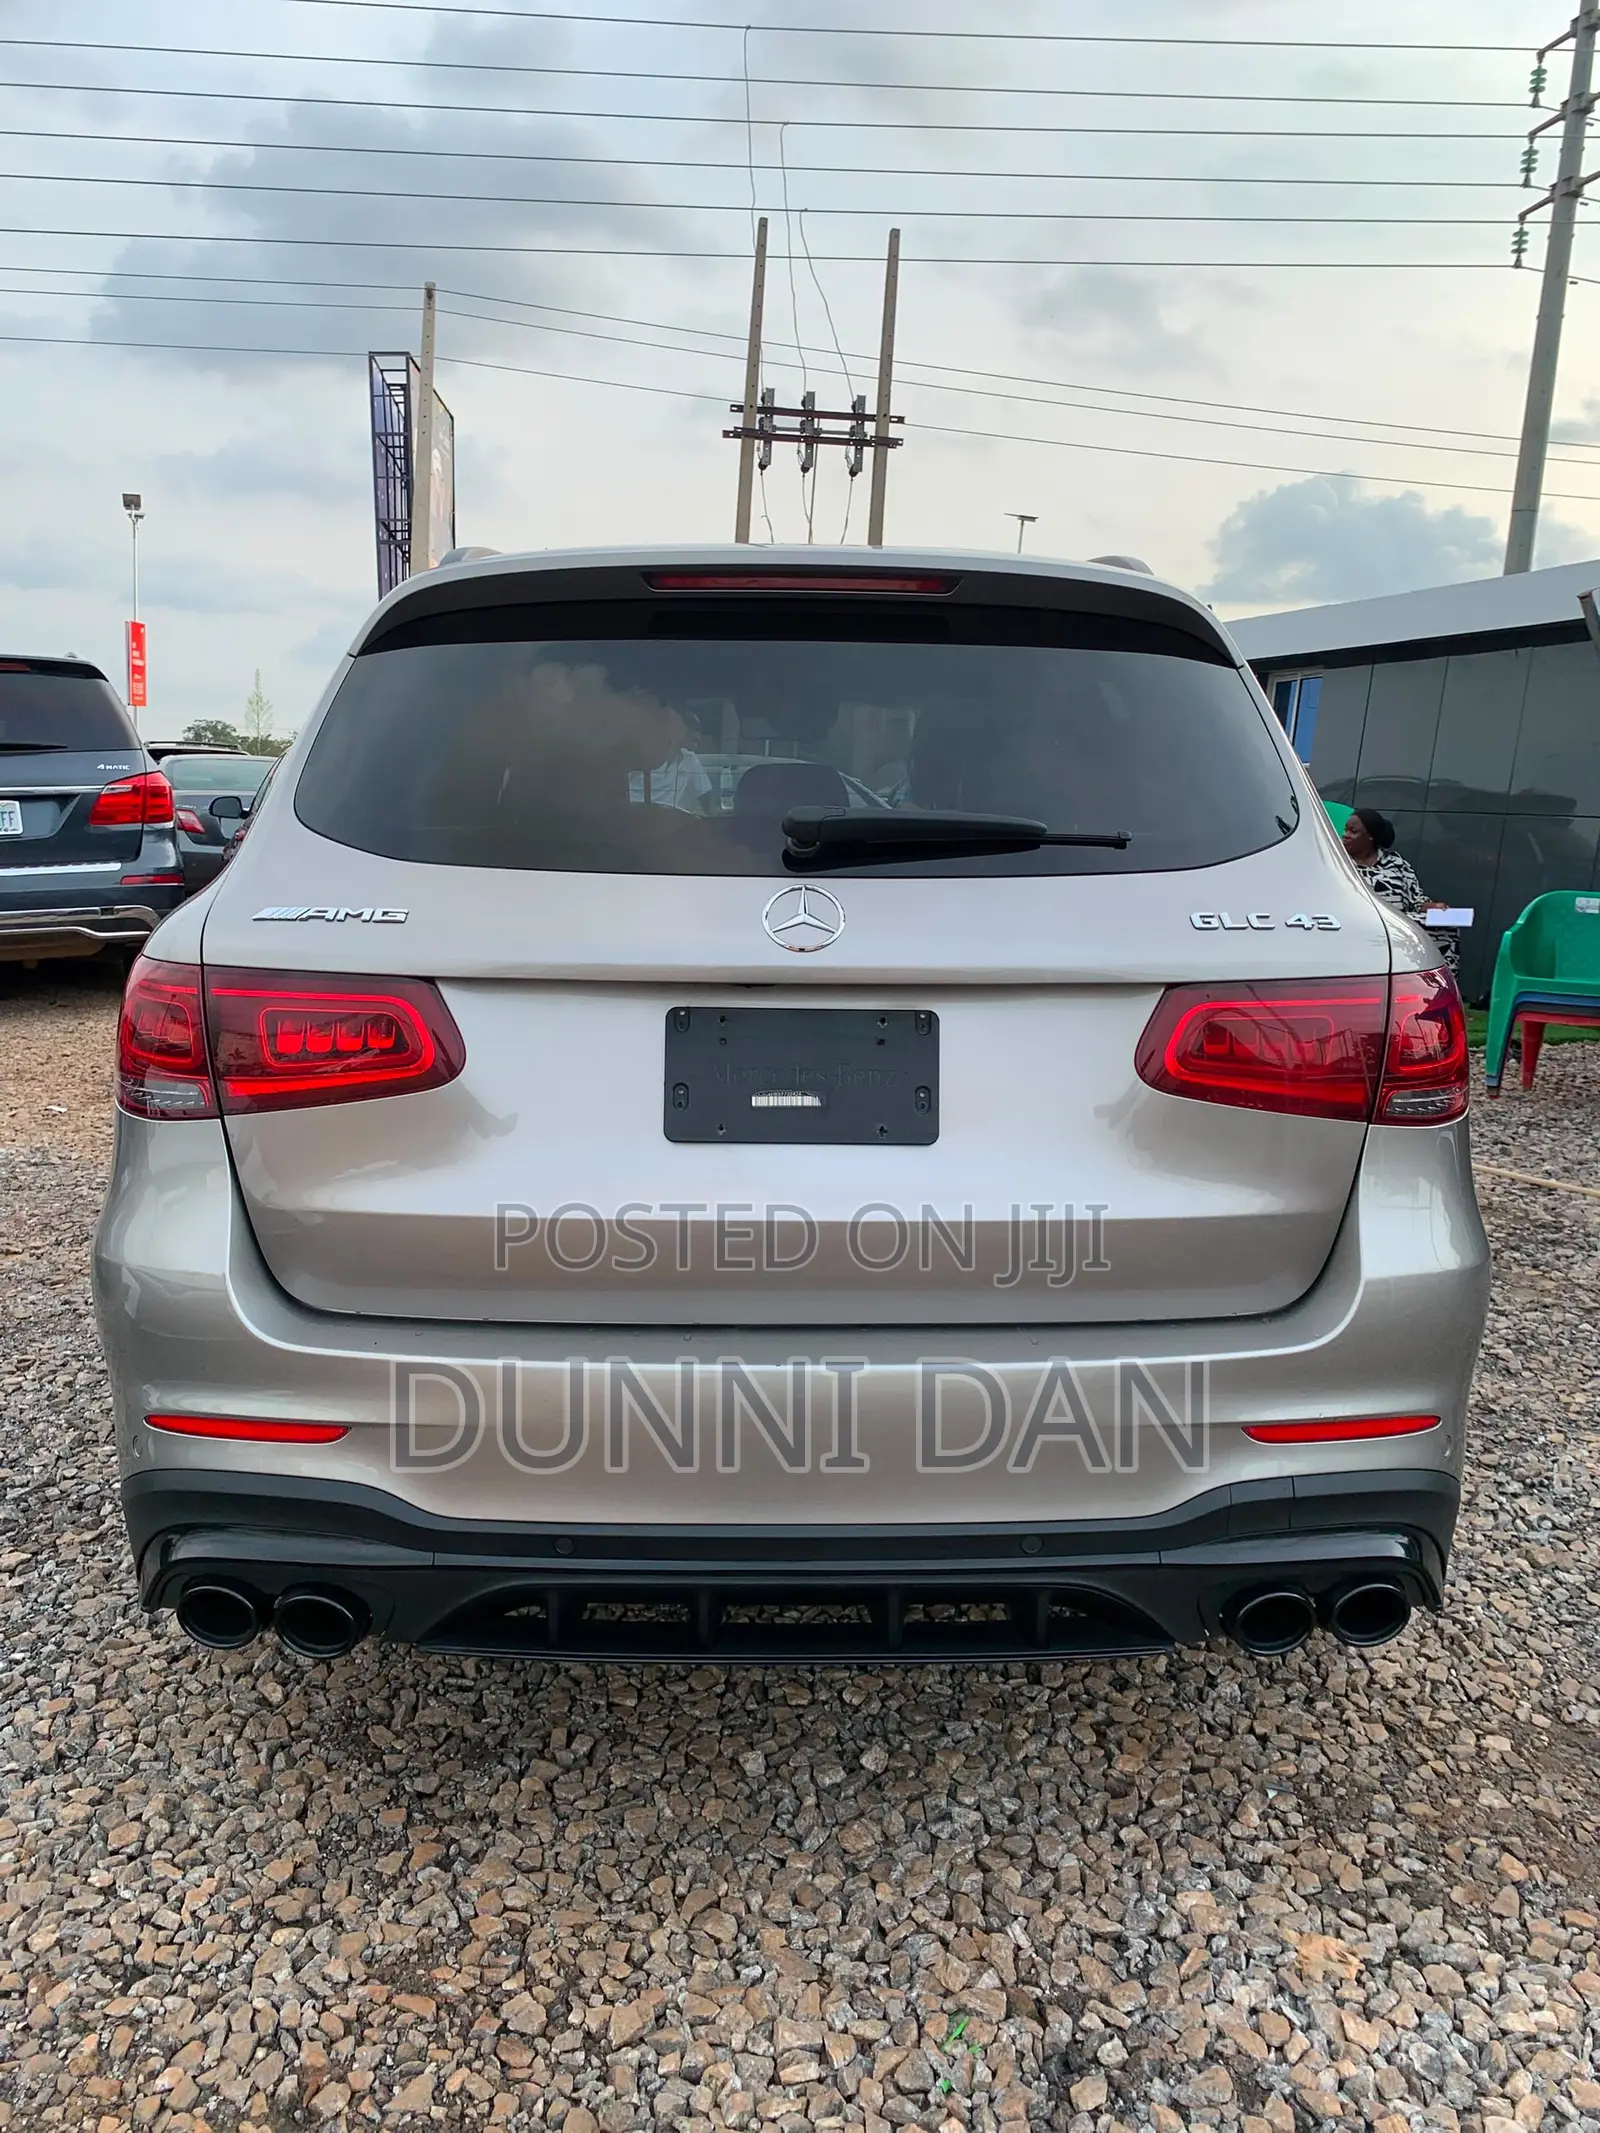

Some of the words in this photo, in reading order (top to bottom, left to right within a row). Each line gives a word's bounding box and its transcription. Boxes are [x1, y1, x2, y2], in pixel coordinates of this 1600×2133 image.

[296, 906, 410, 923] AMG
[1189, 912, 1276, 931] GLC
[1285, 913, 1342, 931] 43
